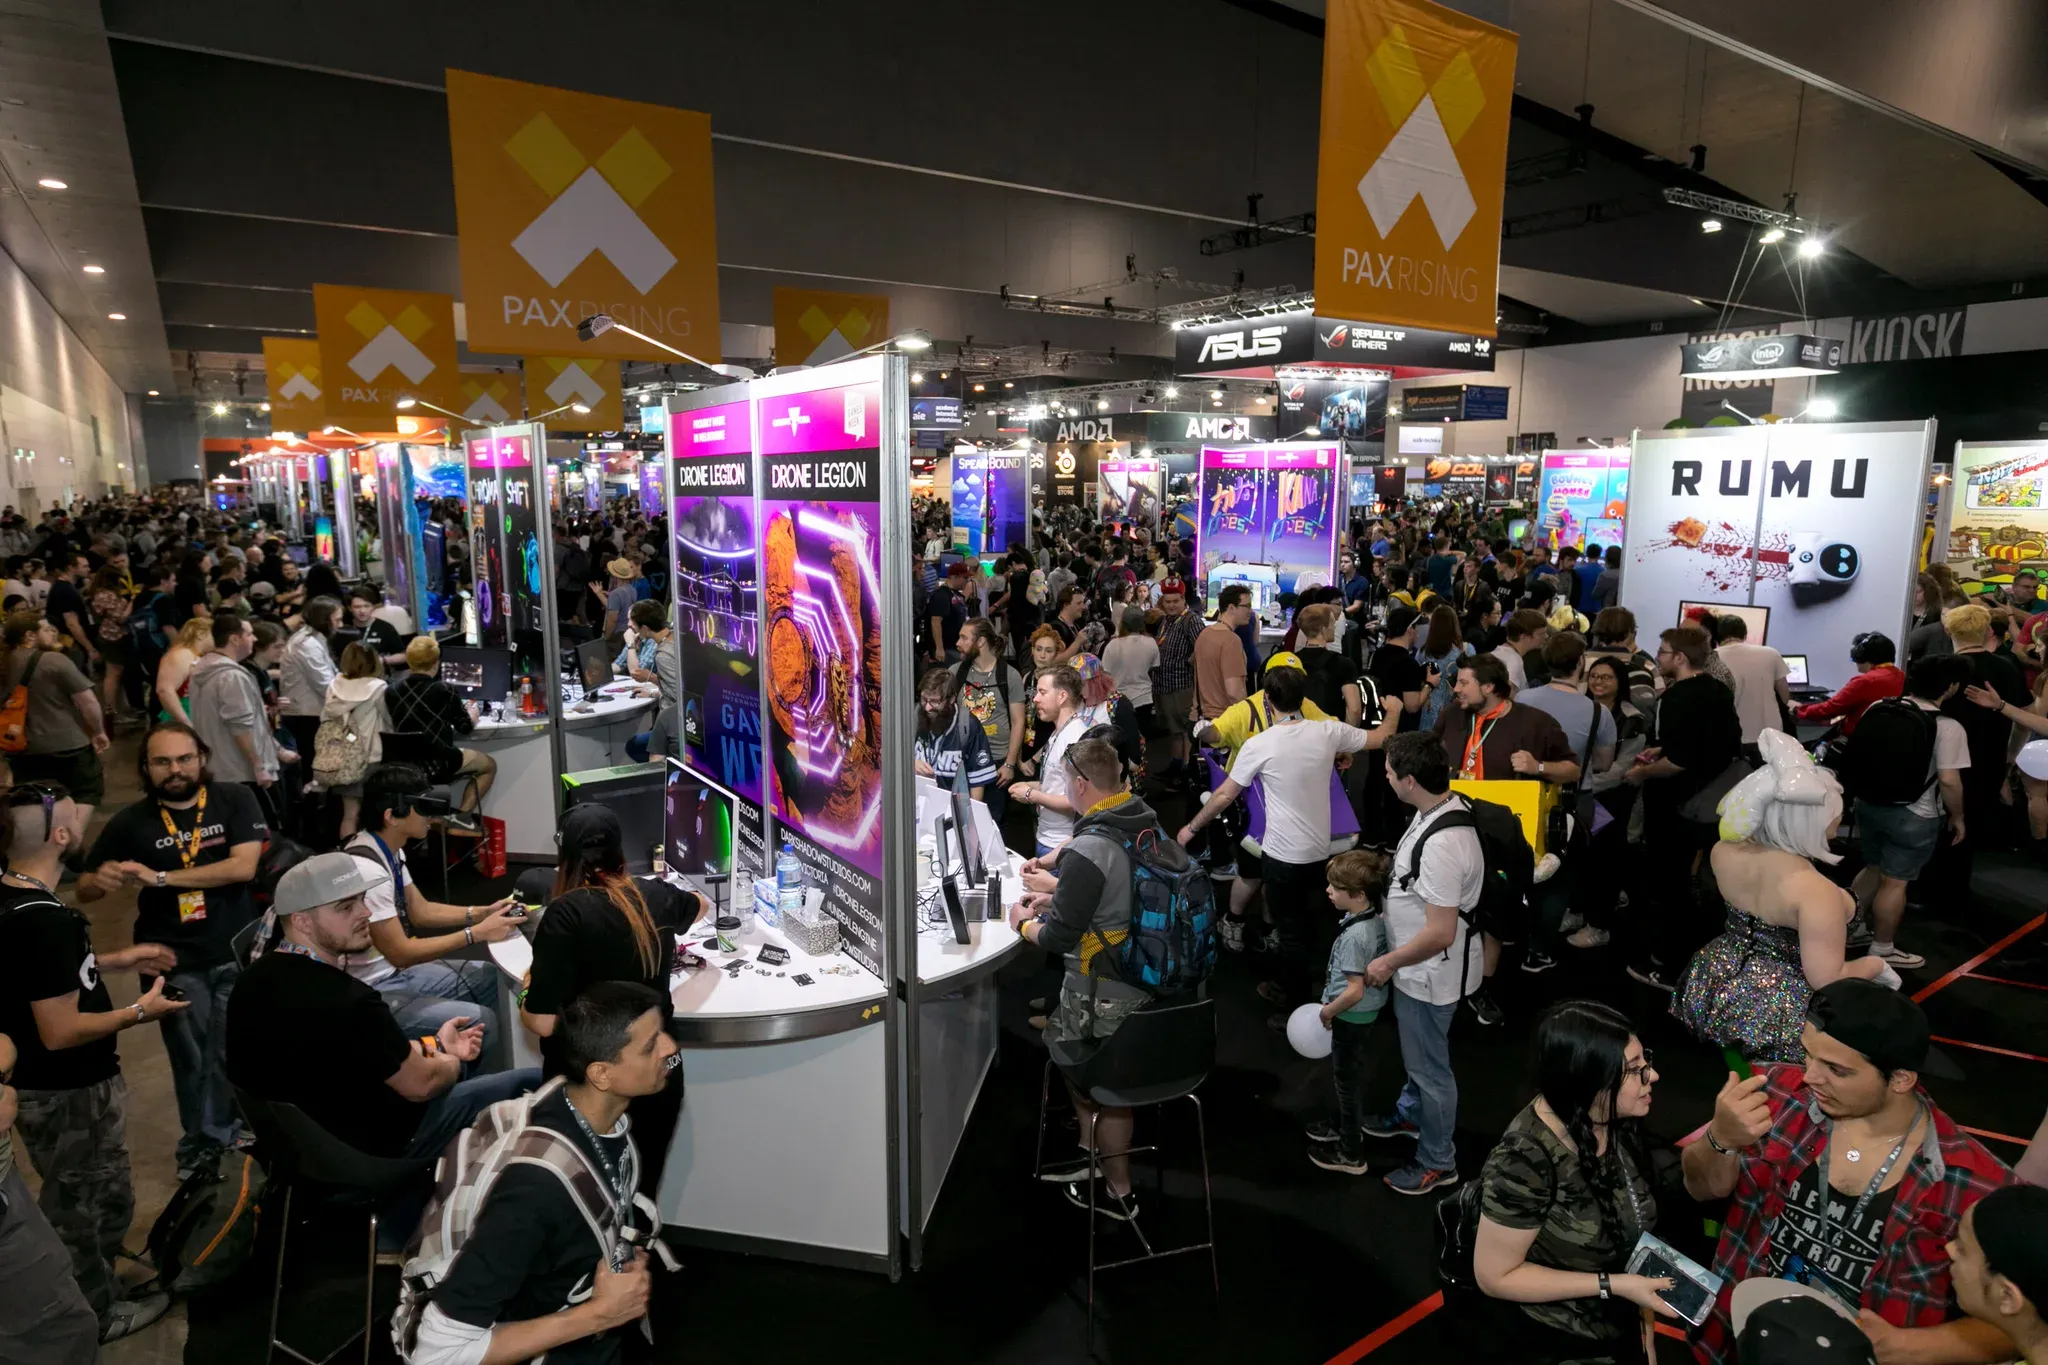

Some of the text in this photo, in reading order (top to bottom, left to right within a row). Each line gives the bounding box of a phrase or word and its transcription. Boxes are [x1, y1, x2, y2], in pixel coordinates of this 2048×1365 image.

[1343, 247, 1478, 302] PAX RISING
[503, 295, 574, 328] PAX
[1197, 325, 1282, 363] ASUS
[1352, 328, 1406, 342] REPUBLIC OF
[1352, 340, 1388, 351] GAMERS
[1449, 341, 1465, 353] AMD
[1852, 311, 1963, 364] KIOSK
[1756, 348, 1779, 359] intel
[342, 387, 380, 404] PAX
[912, 412, 926, 420] aie
[1185, 417, 1235, 439] AMD
[1057, 420, 1097, 440] AMD
[680, 465, 709, 487] DRONE
[709, 462, 746, 486] LEGION
[771, 461, 867, 488] DRONE LEGION
[1671, 457, 1870, 499] RUMU
[685, 717, 697, 735] aie
[832, 883, 883, 934] #DRONELEGION
[826, 900, 877, 953] #UNREALENGINE
[1853, 1173, 1883, 1218] ALIENWARE
[1788, 1179, 1884, 1243] REMIE
